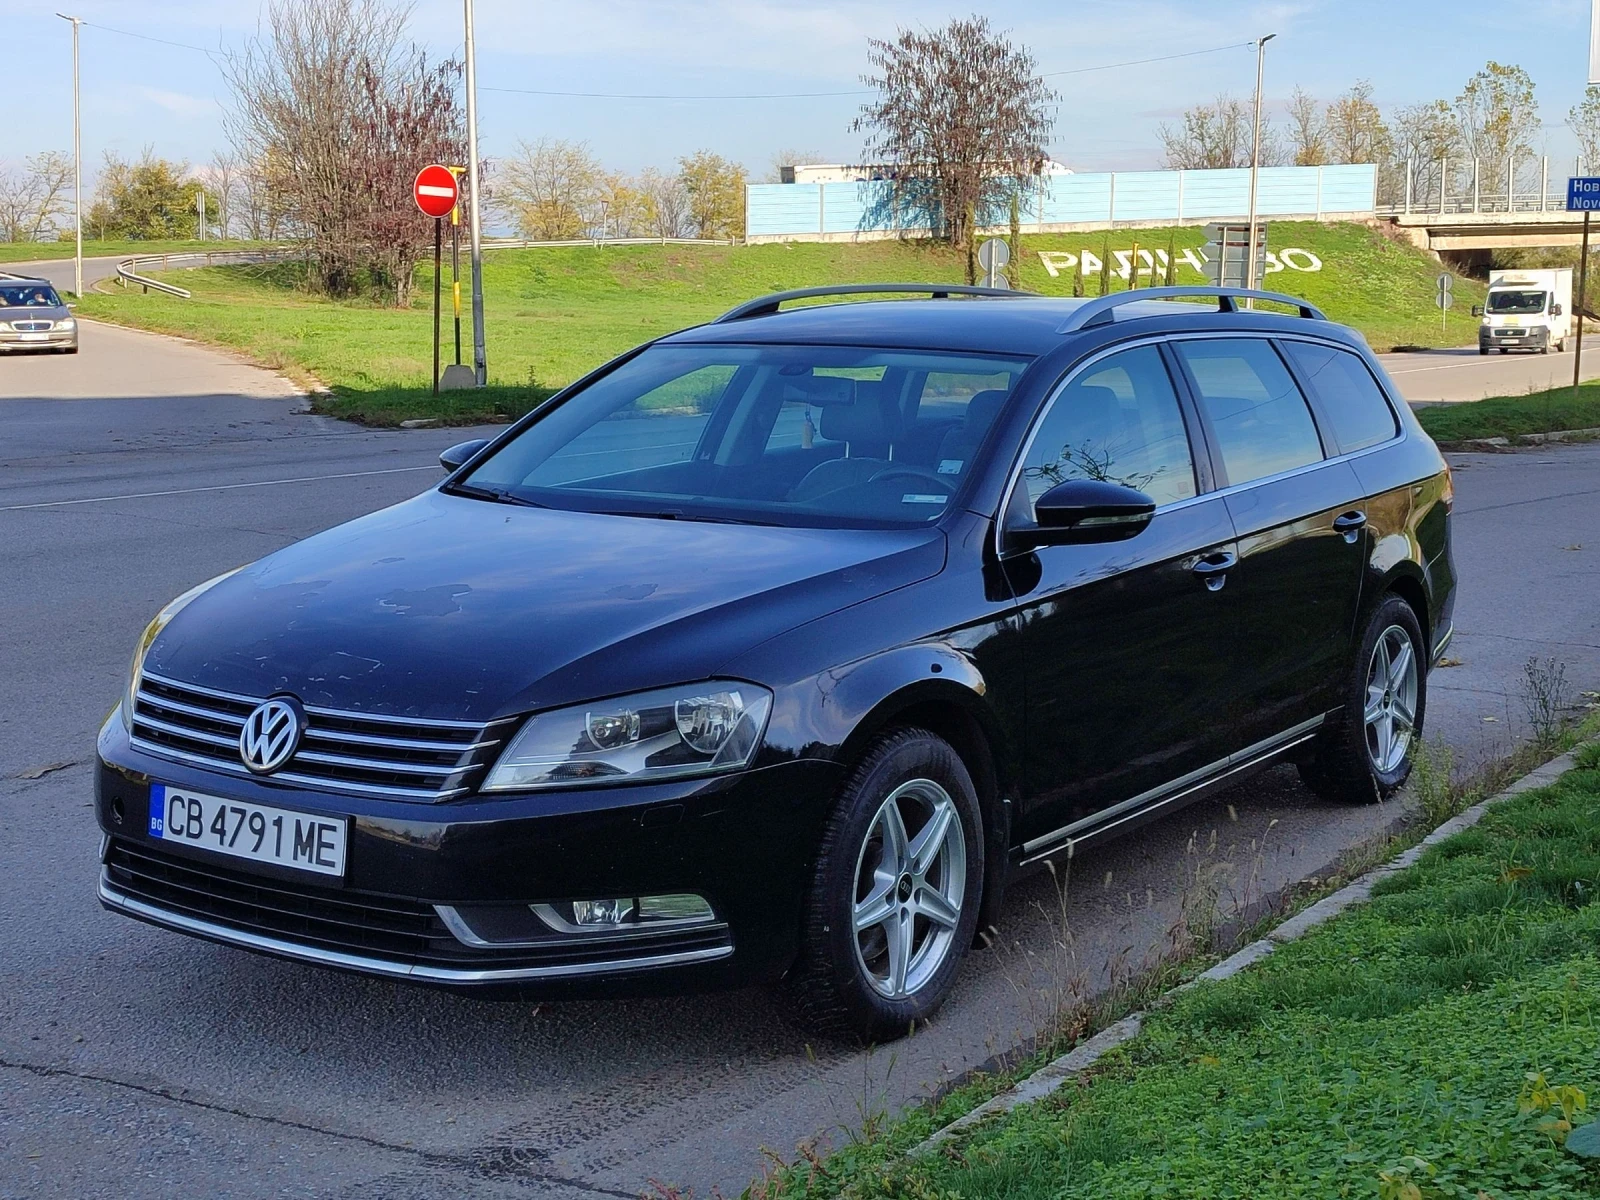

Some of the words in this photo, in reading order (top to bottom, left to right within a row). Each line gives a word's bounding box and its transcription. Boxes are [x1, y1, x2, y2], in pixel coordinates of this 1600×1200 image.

[1573, 196, 1600, 209] Nov
[150, 817, 163, 831] BG
[167, 794, 204, 840] CB
[210, 804, 284, 858] 4791
[292, 818, 338, 869] ME
